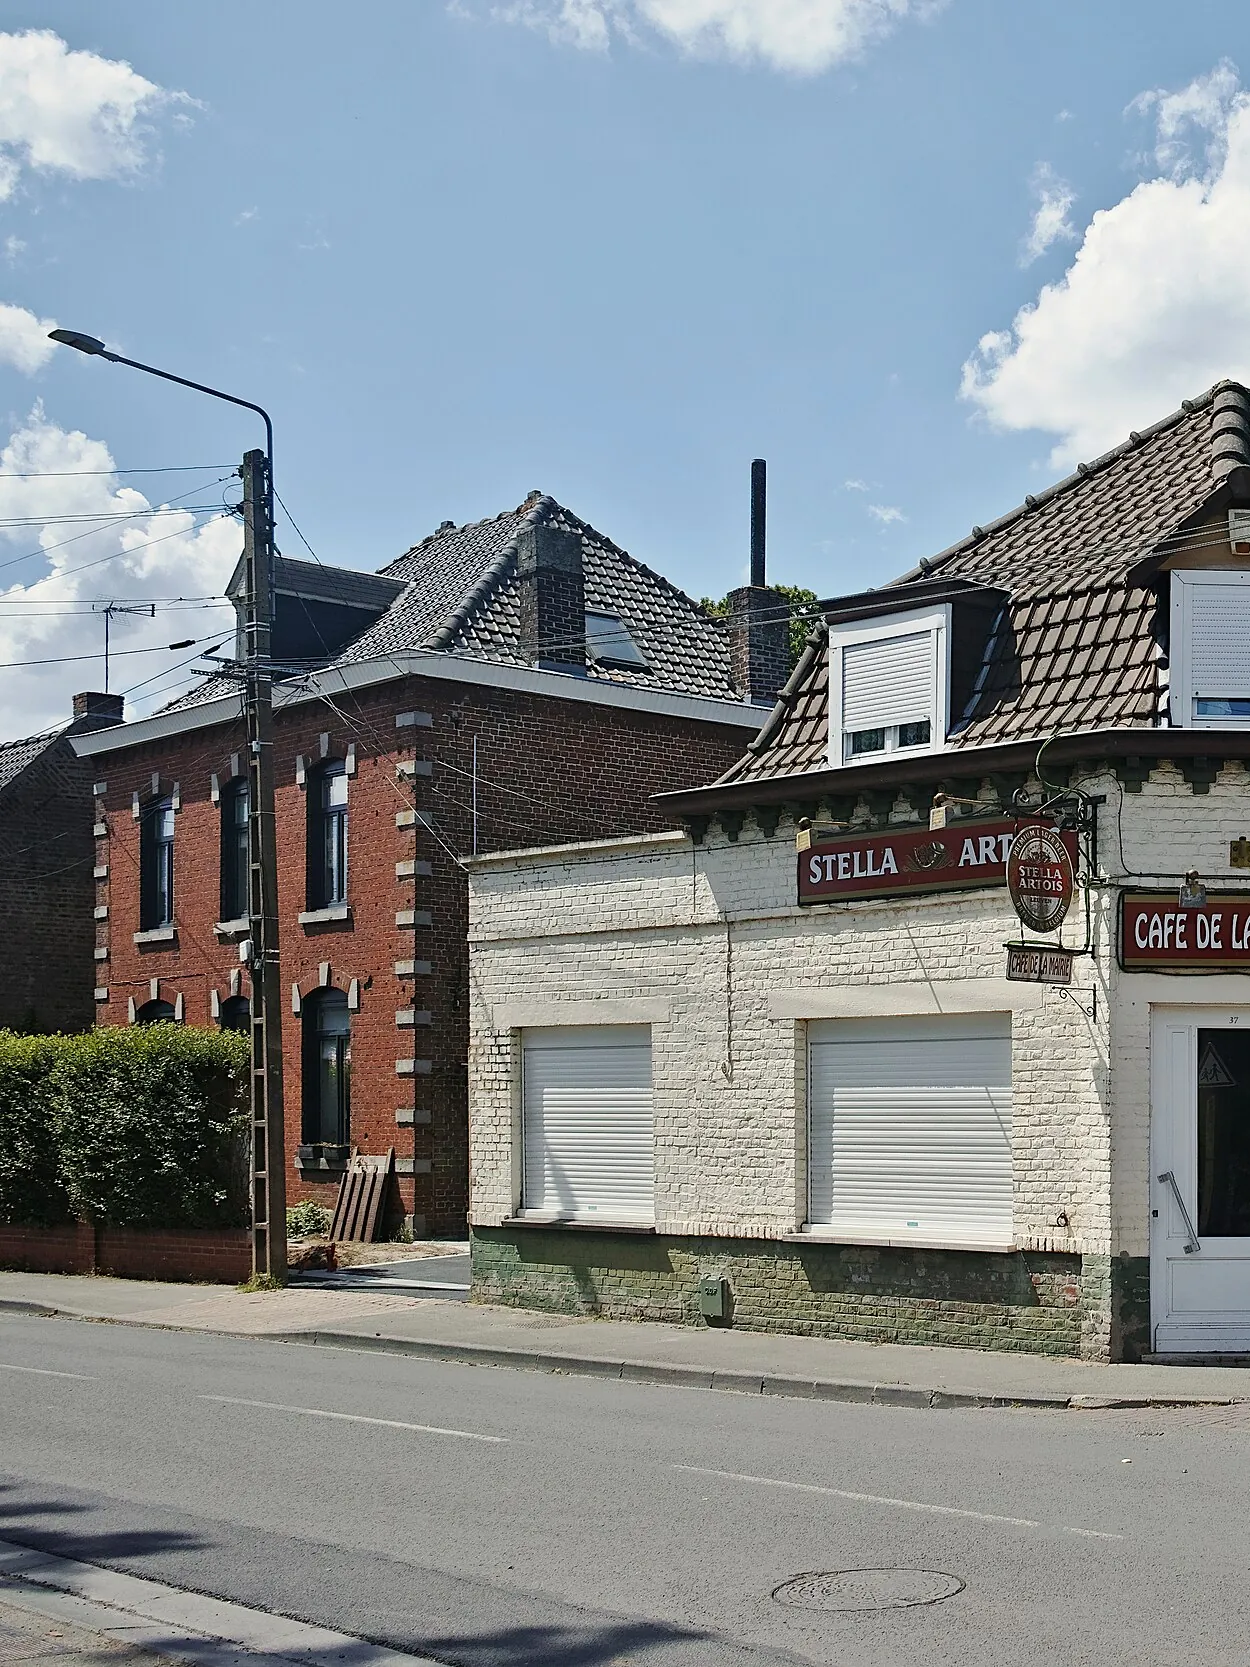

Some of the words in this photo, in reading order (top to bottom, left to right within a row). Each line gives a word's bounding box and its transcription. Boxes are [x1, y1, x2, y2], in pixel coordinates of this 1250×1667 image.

[1012, 829, 1036, 857] PREMIUM
[1054, 843, 1067, 861] BEER
[808, 847, 899, 884] STELLA
[957, 833, 1014, 868] ART
[1018, 865, 1063, 880] STELLA
[1018, 878, 1063, 892] ARTOIS
[1134, 912, 1188, 950] CAFE
[1196, 913, 1223, 949] DE
[1011, 953, 1029, 974] CAFE
[1030, 955, 1039, 974] DE
[1049, 957, 1070, 977] MAIRIE
[1228, 1016, 1239, 1024] 37
